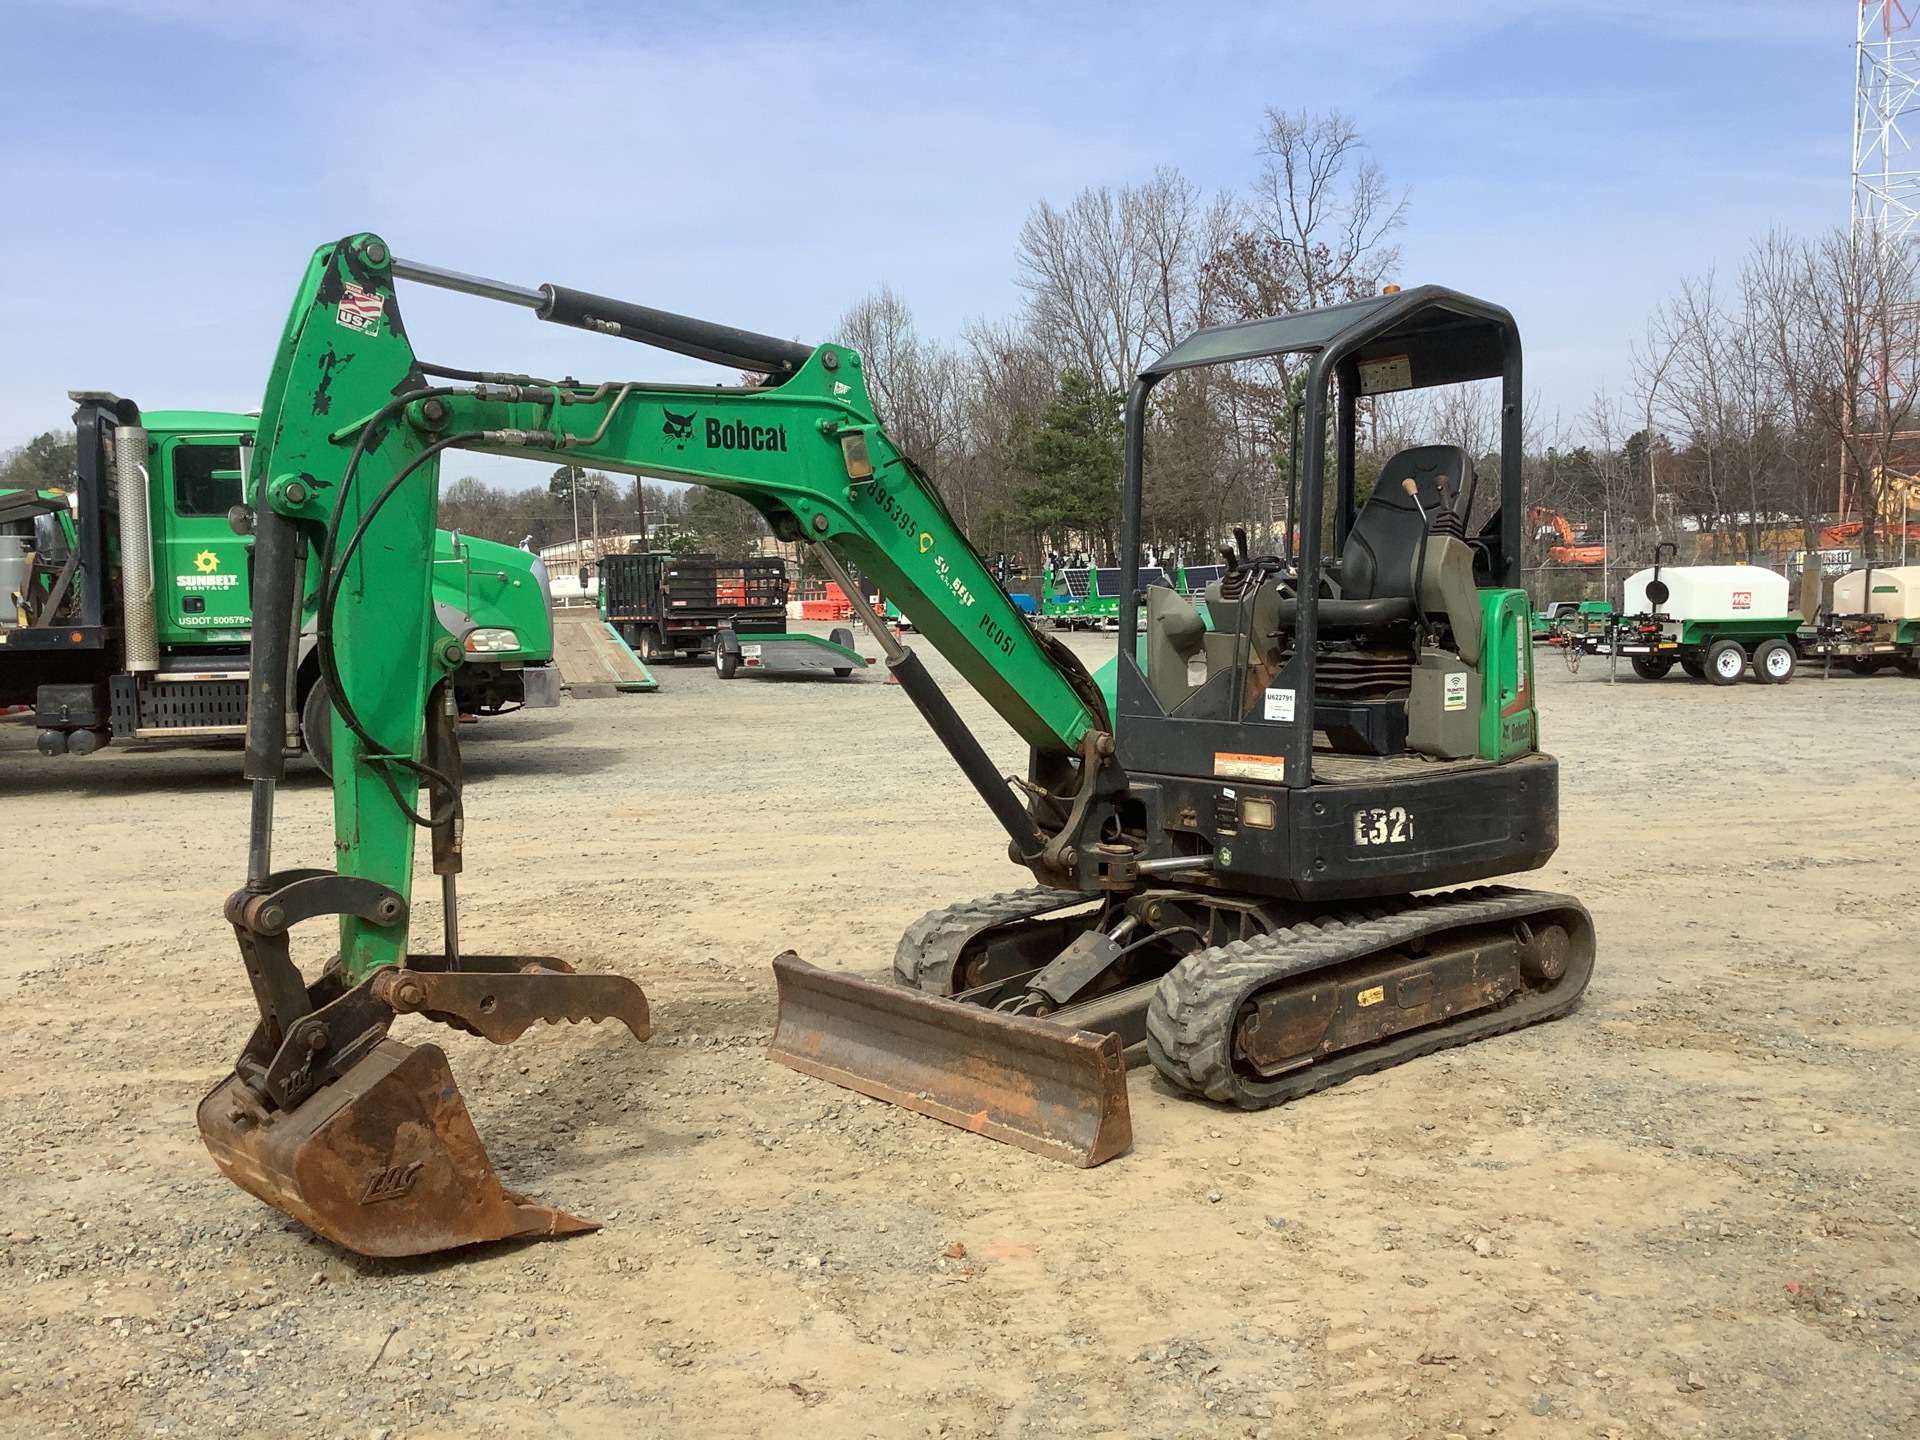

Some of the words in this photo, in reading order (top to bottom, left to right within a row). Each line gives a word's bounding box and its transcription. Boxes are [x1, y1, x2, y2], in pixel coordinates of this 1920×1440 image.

[705, 417, 787, 452] Bobcat
[866, 481, 918, 537] 895395
[176, 574, 238, 586] SUNBELT
[934, 555, 975, 606] SUBELT
[178, 616, 211, 625] USDOT
[213, 615, 244, 624] 500579
[1267, 693, 1293, 701] U622791
